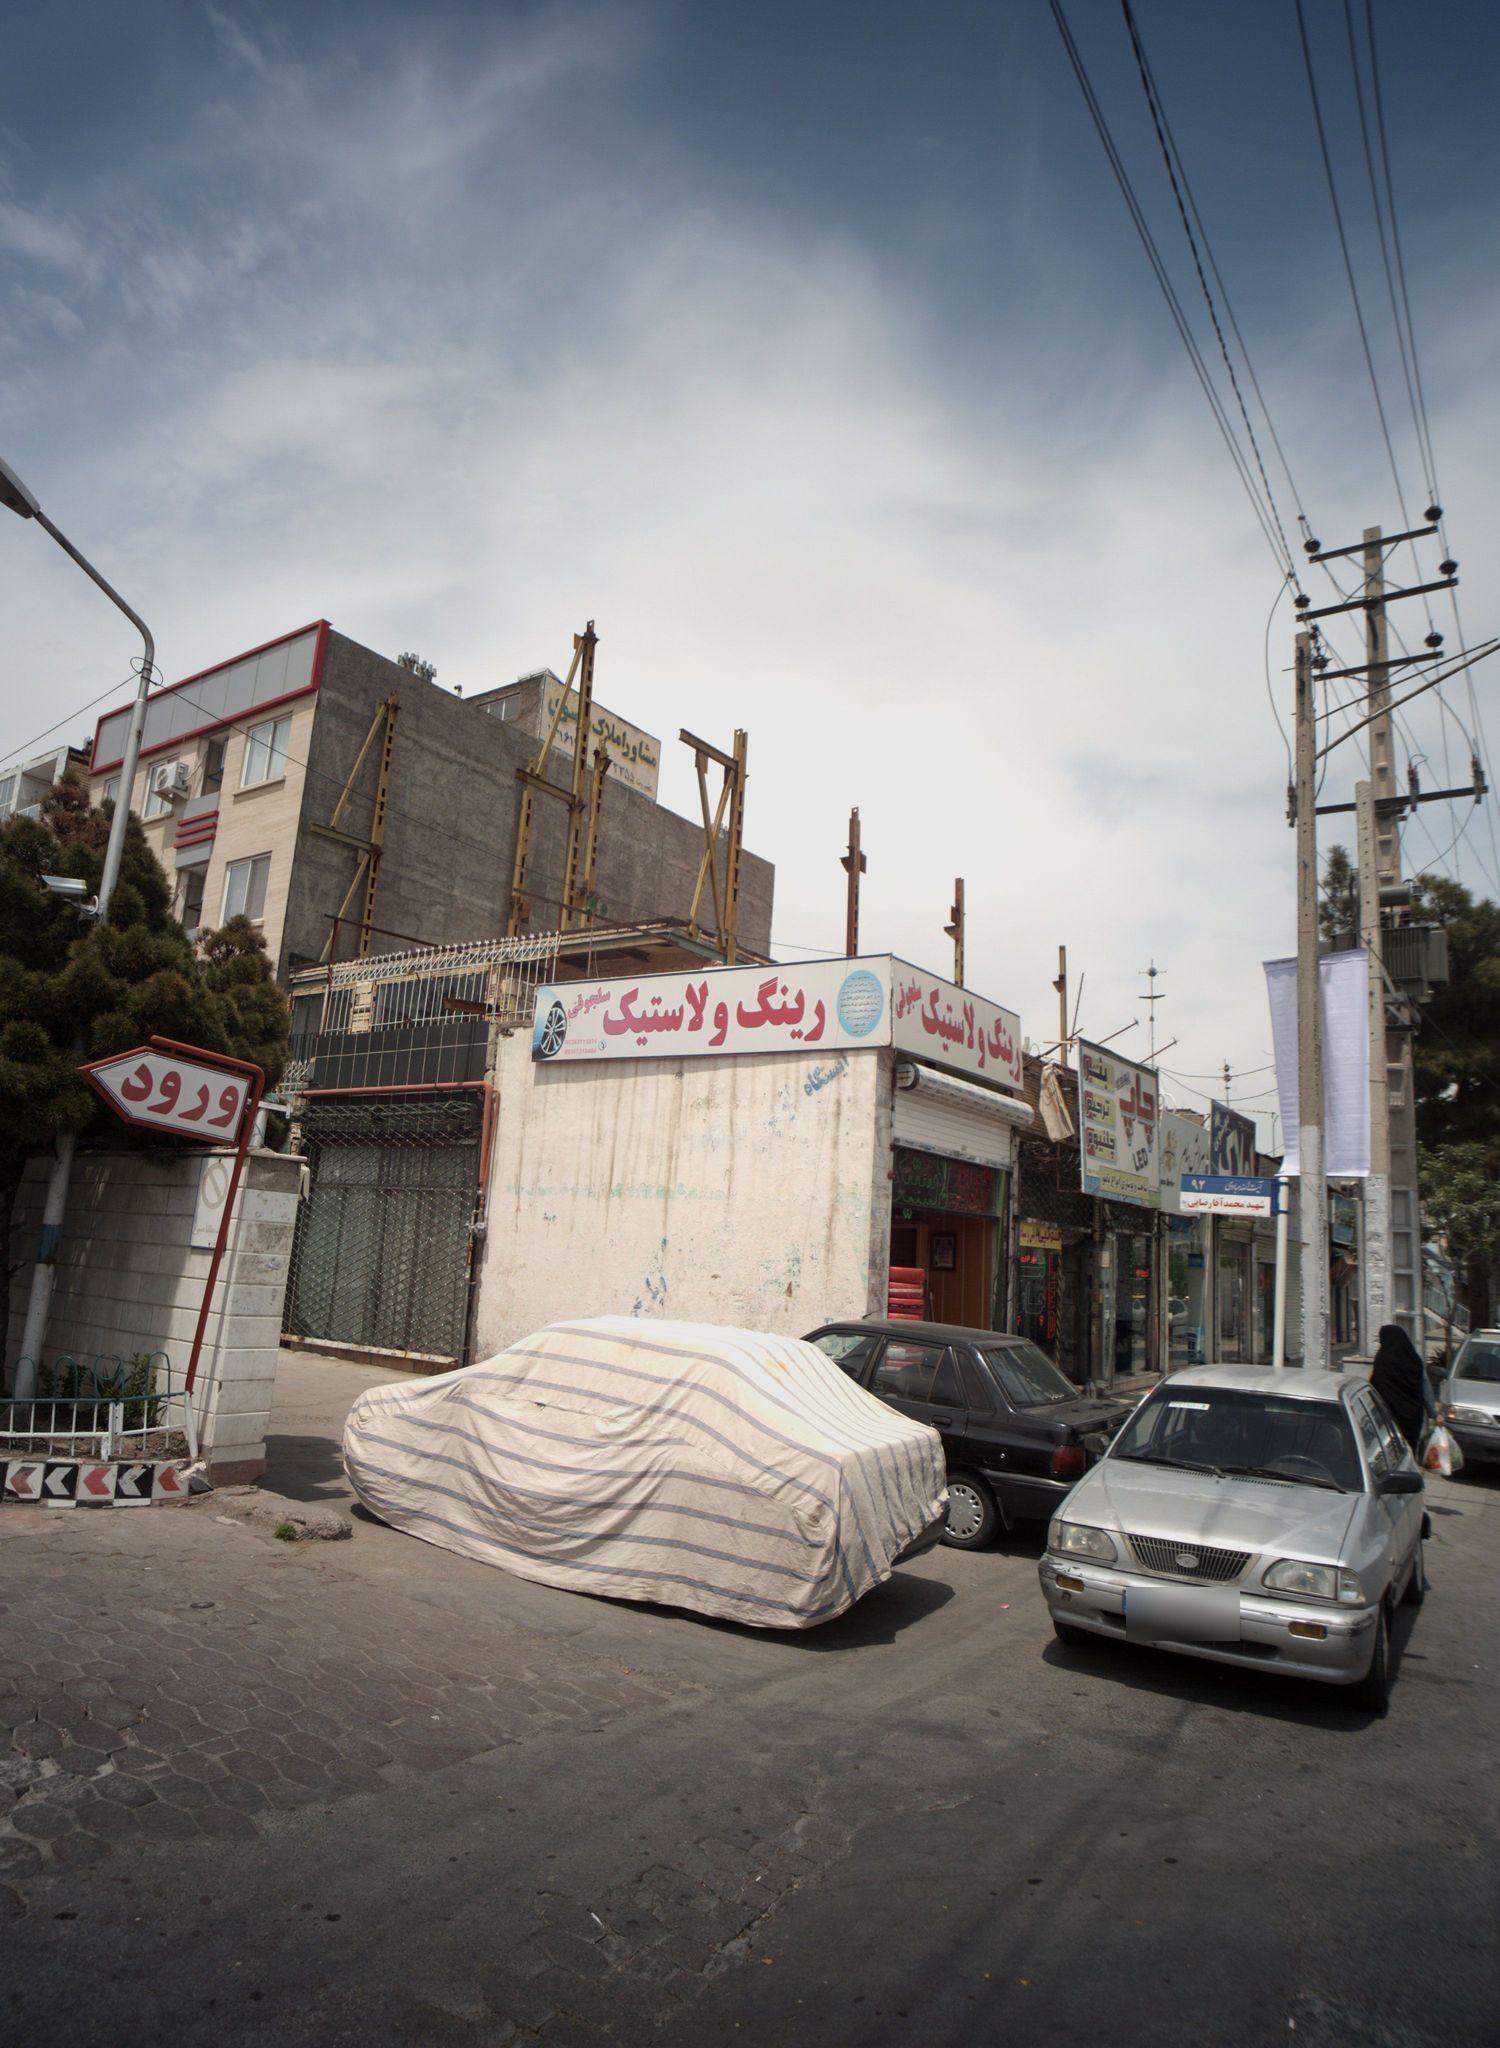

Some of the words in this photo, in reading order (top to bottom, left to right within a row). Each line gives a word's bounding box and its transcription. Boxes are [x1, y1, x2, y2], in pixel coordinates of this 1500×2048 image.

[592, 718, 626, 748] املاک
[622, 741, 657, 767] مشاور
[602, 980, 709, 1047] لاستیک
[708, 1000, 728, 1046] و
[736, 976, 826, 1043] رینگ
[921, 988, 975, 1052] لاستیک
[977, 1026, 985, 1068] و
[987, 1018, 1020, 1082] رینگ
[121, 1063, 239, 1128] ورود
[1132, 1148, 1149, 1172] LED
[1223, 1199, 1244, 1208] محمد
[1246, 1200, 1265, 1210] شهید
